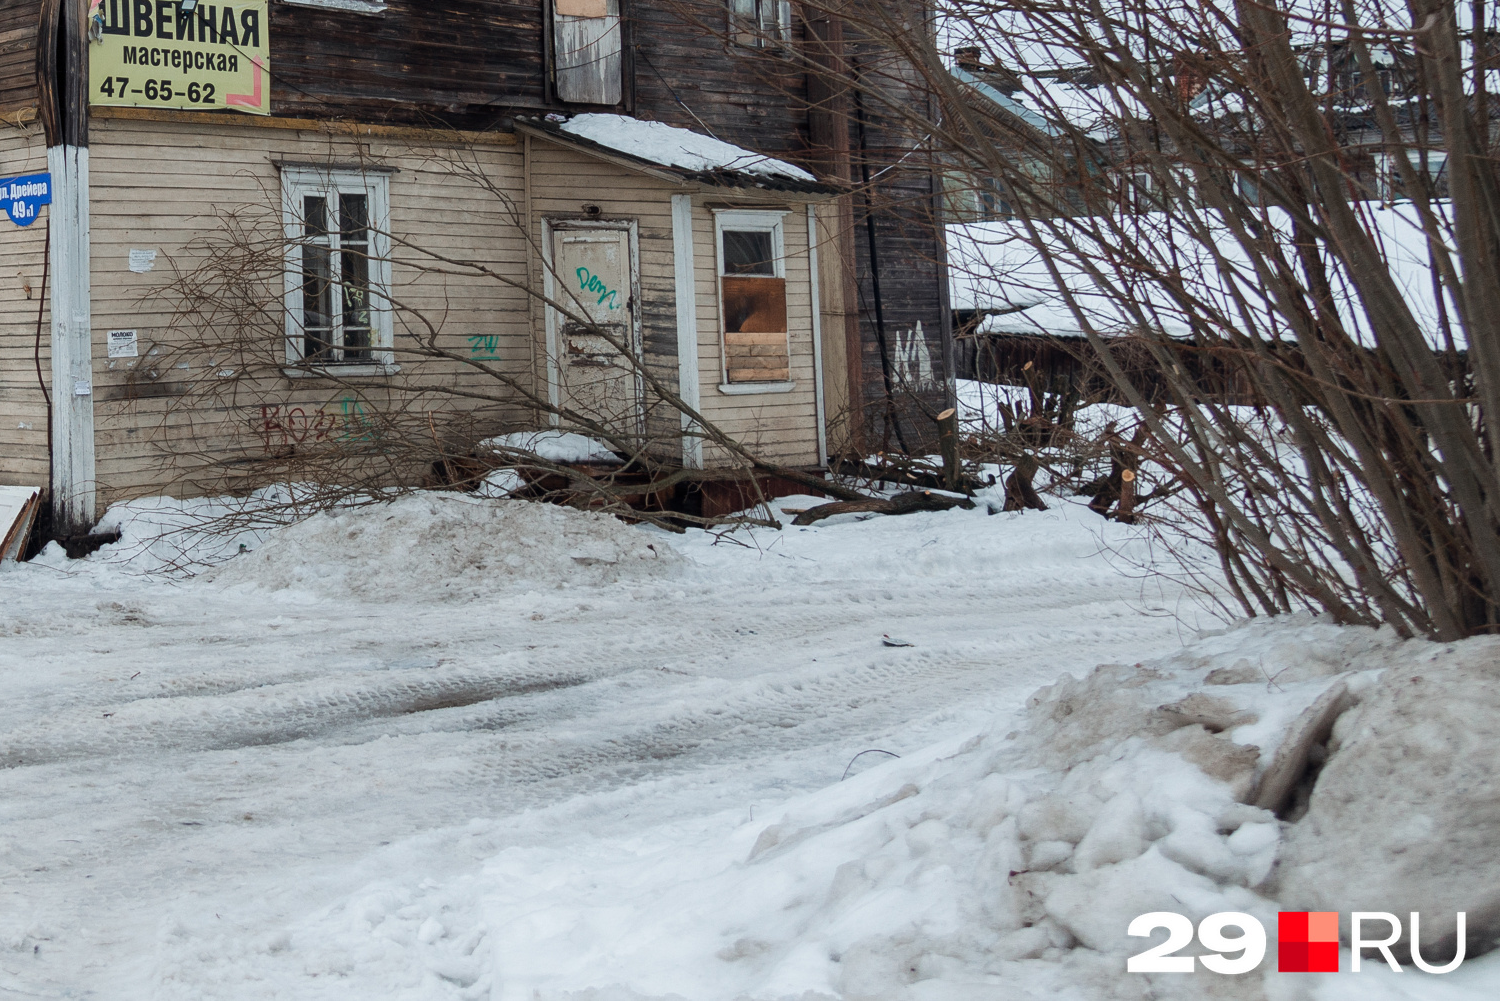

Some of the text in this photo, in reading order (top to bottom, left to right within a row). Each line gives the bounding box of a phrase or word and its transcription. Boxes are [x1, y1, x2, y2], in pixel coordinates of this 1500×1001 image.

[123, 45, 238, 74] мастерская
[100, 76, 216, 104] 47-65-62
[10, 181, 48, 201] Дрейера
